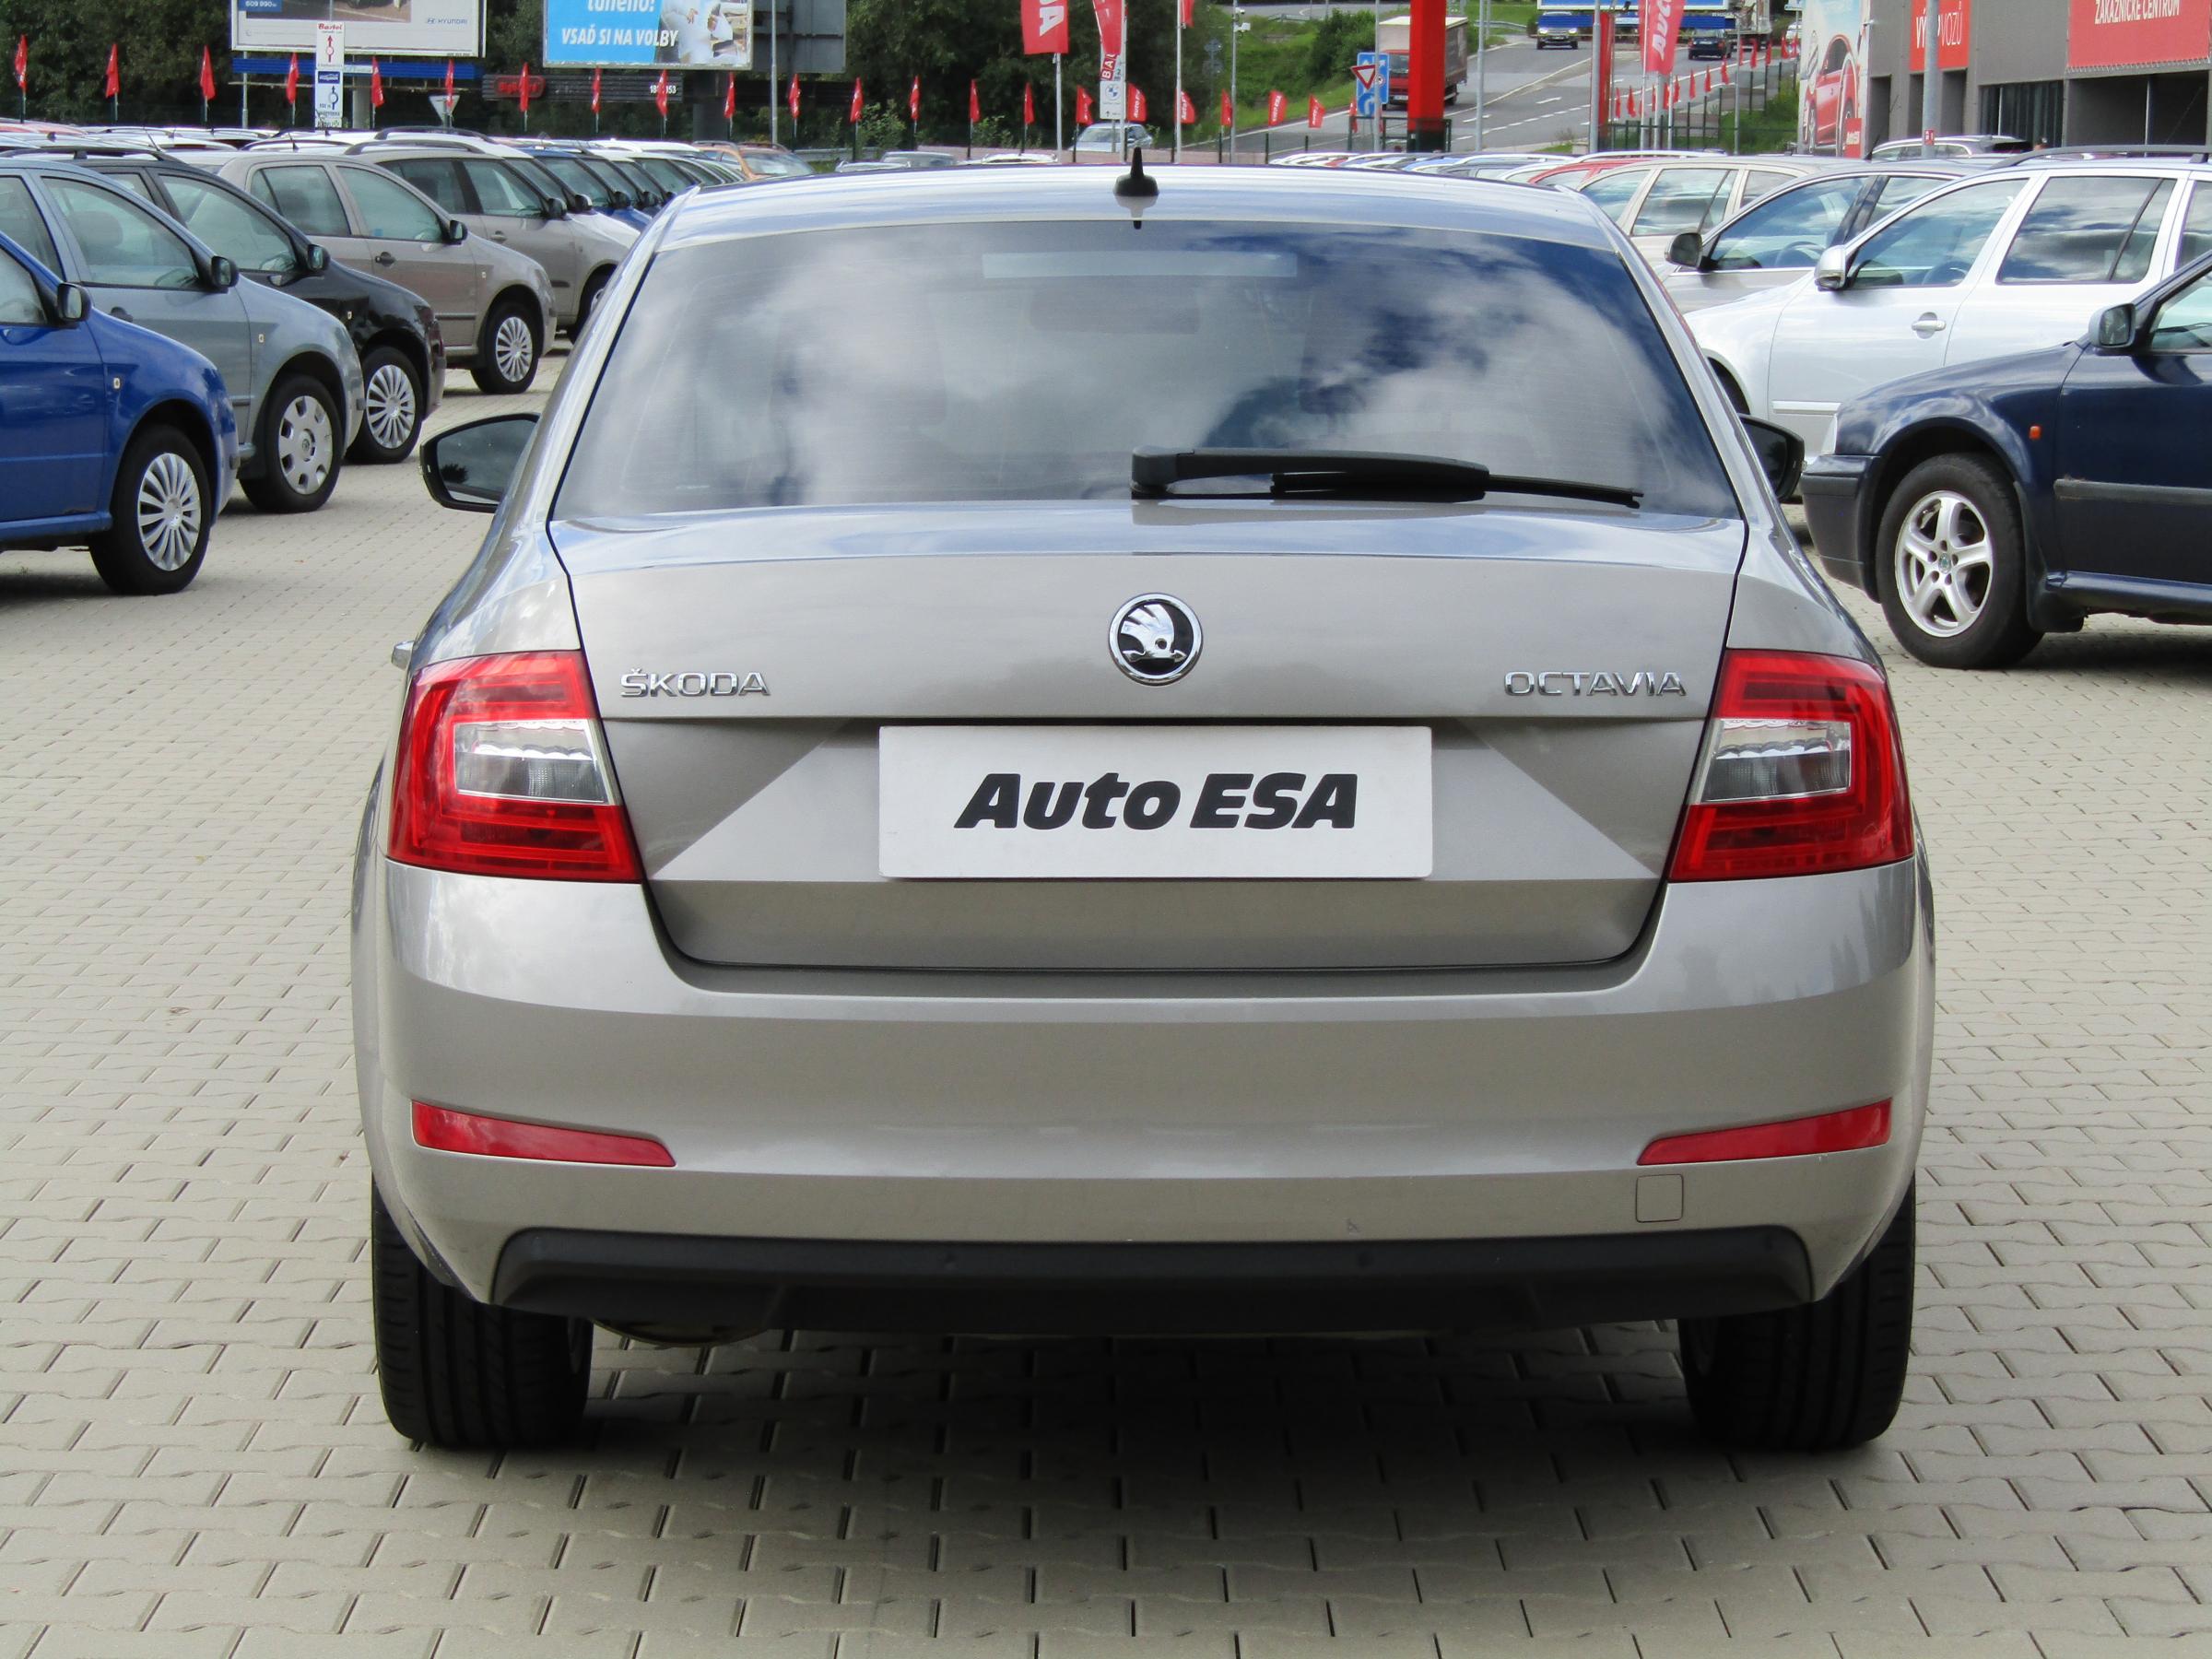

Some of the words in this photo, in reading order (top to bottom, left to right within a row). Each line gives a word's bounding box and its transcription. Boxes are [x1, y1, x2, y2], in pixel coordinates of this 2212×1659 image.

[561, 24, 596, 45] VSAĎ
[598, 29, 610, 45] SI
[613, 29, 632, 46] NA
[636, 29, 679, 47] VOLBY
[620, 668, 771, 697] ŠKODA
[1504, 671, 1687, 697] OCTAVIA
[954, 772, 1182, 830] Auto
[1189, 772, 1358, 830] ESA
